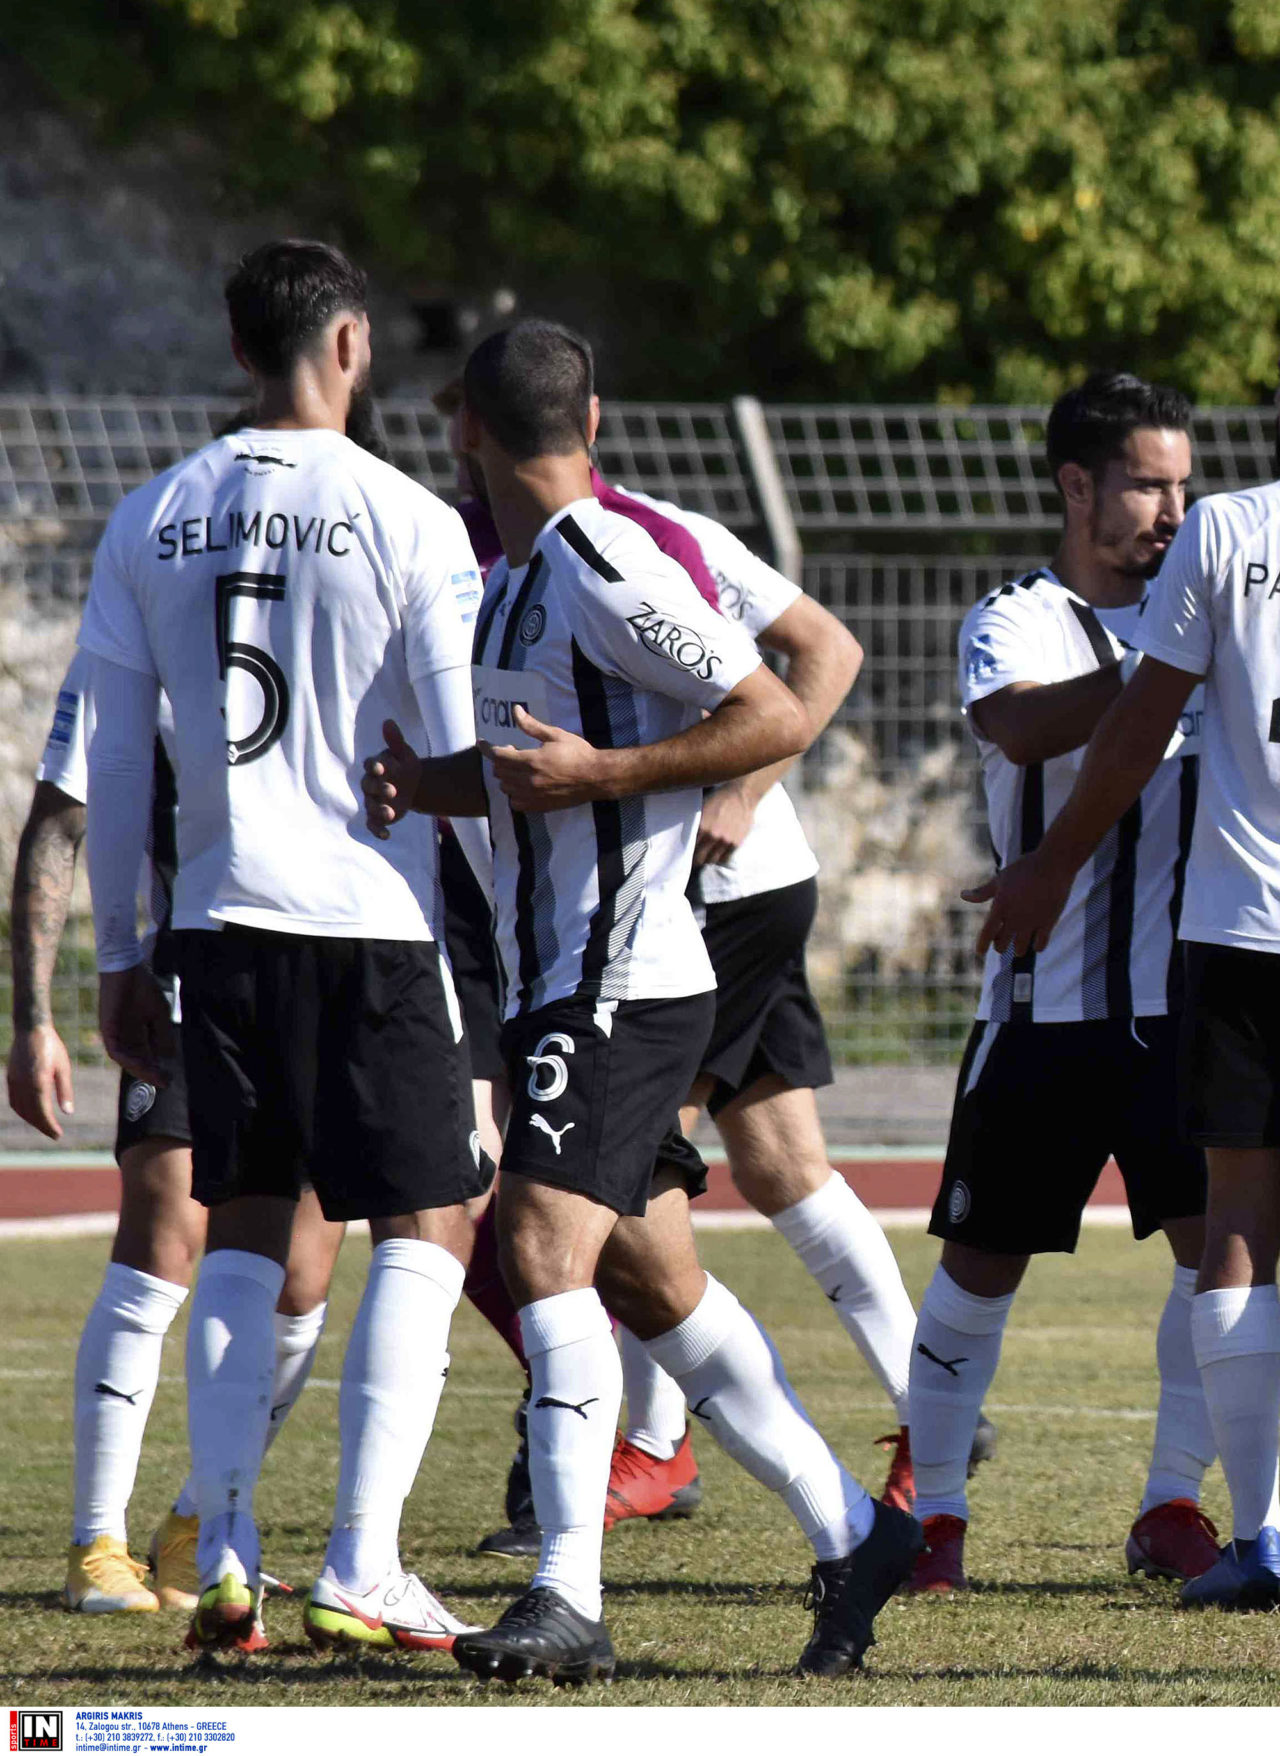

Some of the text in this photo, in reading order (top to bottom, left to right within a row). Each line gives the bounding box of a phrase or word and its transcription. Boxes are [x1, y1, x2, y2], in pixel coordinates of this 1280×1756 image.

[157, 511, 361, 561] SELIMOVIĆ
[214, 571, 291, 766] 5
[526, 1032, 576, 1101] 6
